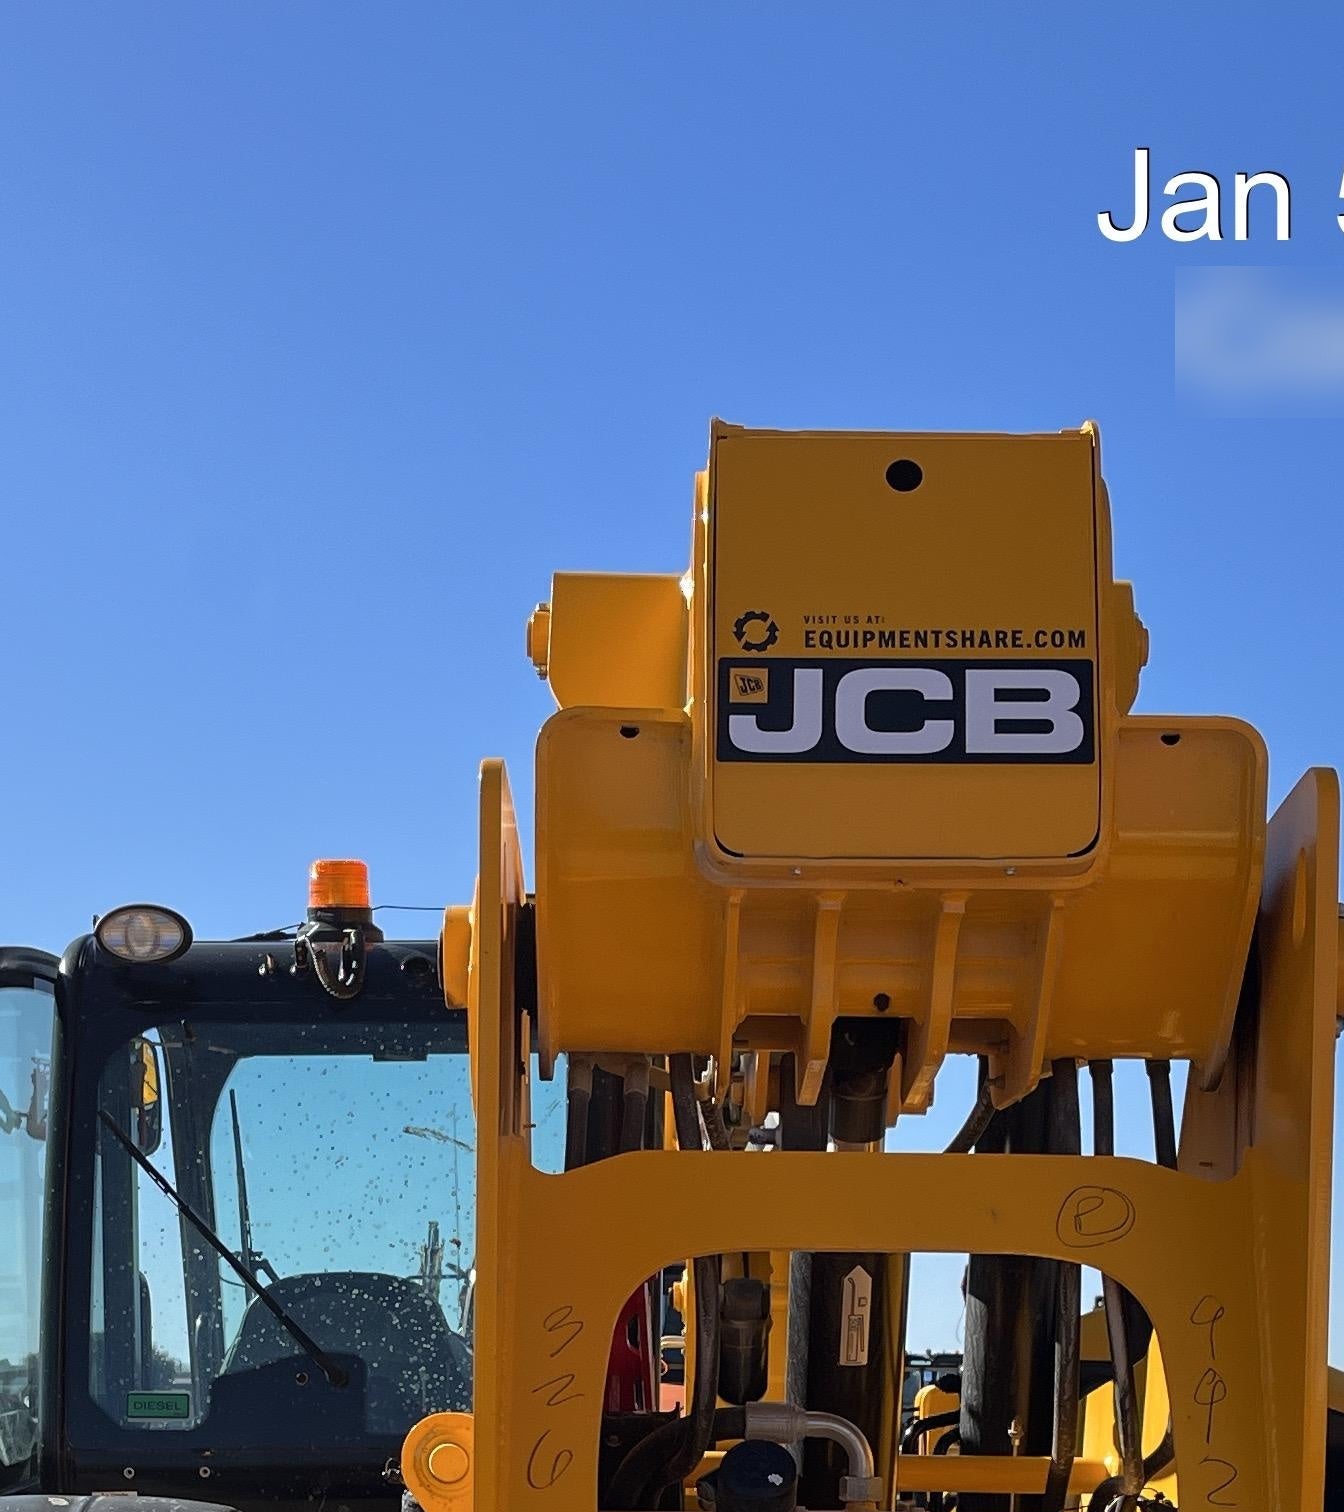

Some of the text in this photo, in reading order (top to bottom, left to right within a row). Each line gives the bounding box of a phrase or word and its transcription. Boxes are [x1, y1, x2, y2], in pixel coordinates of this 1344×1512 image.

[803, 615, 837, 625] VISIT
[844, 615, 860, 625] US
[804, 629, 1087, 650] EQUIPMENTSHARE.COM
[738, 676, 763, 693] JCB
[728, 667, 1085, 755] JCB
[133, 1400, 182, 1411] DIESEL
